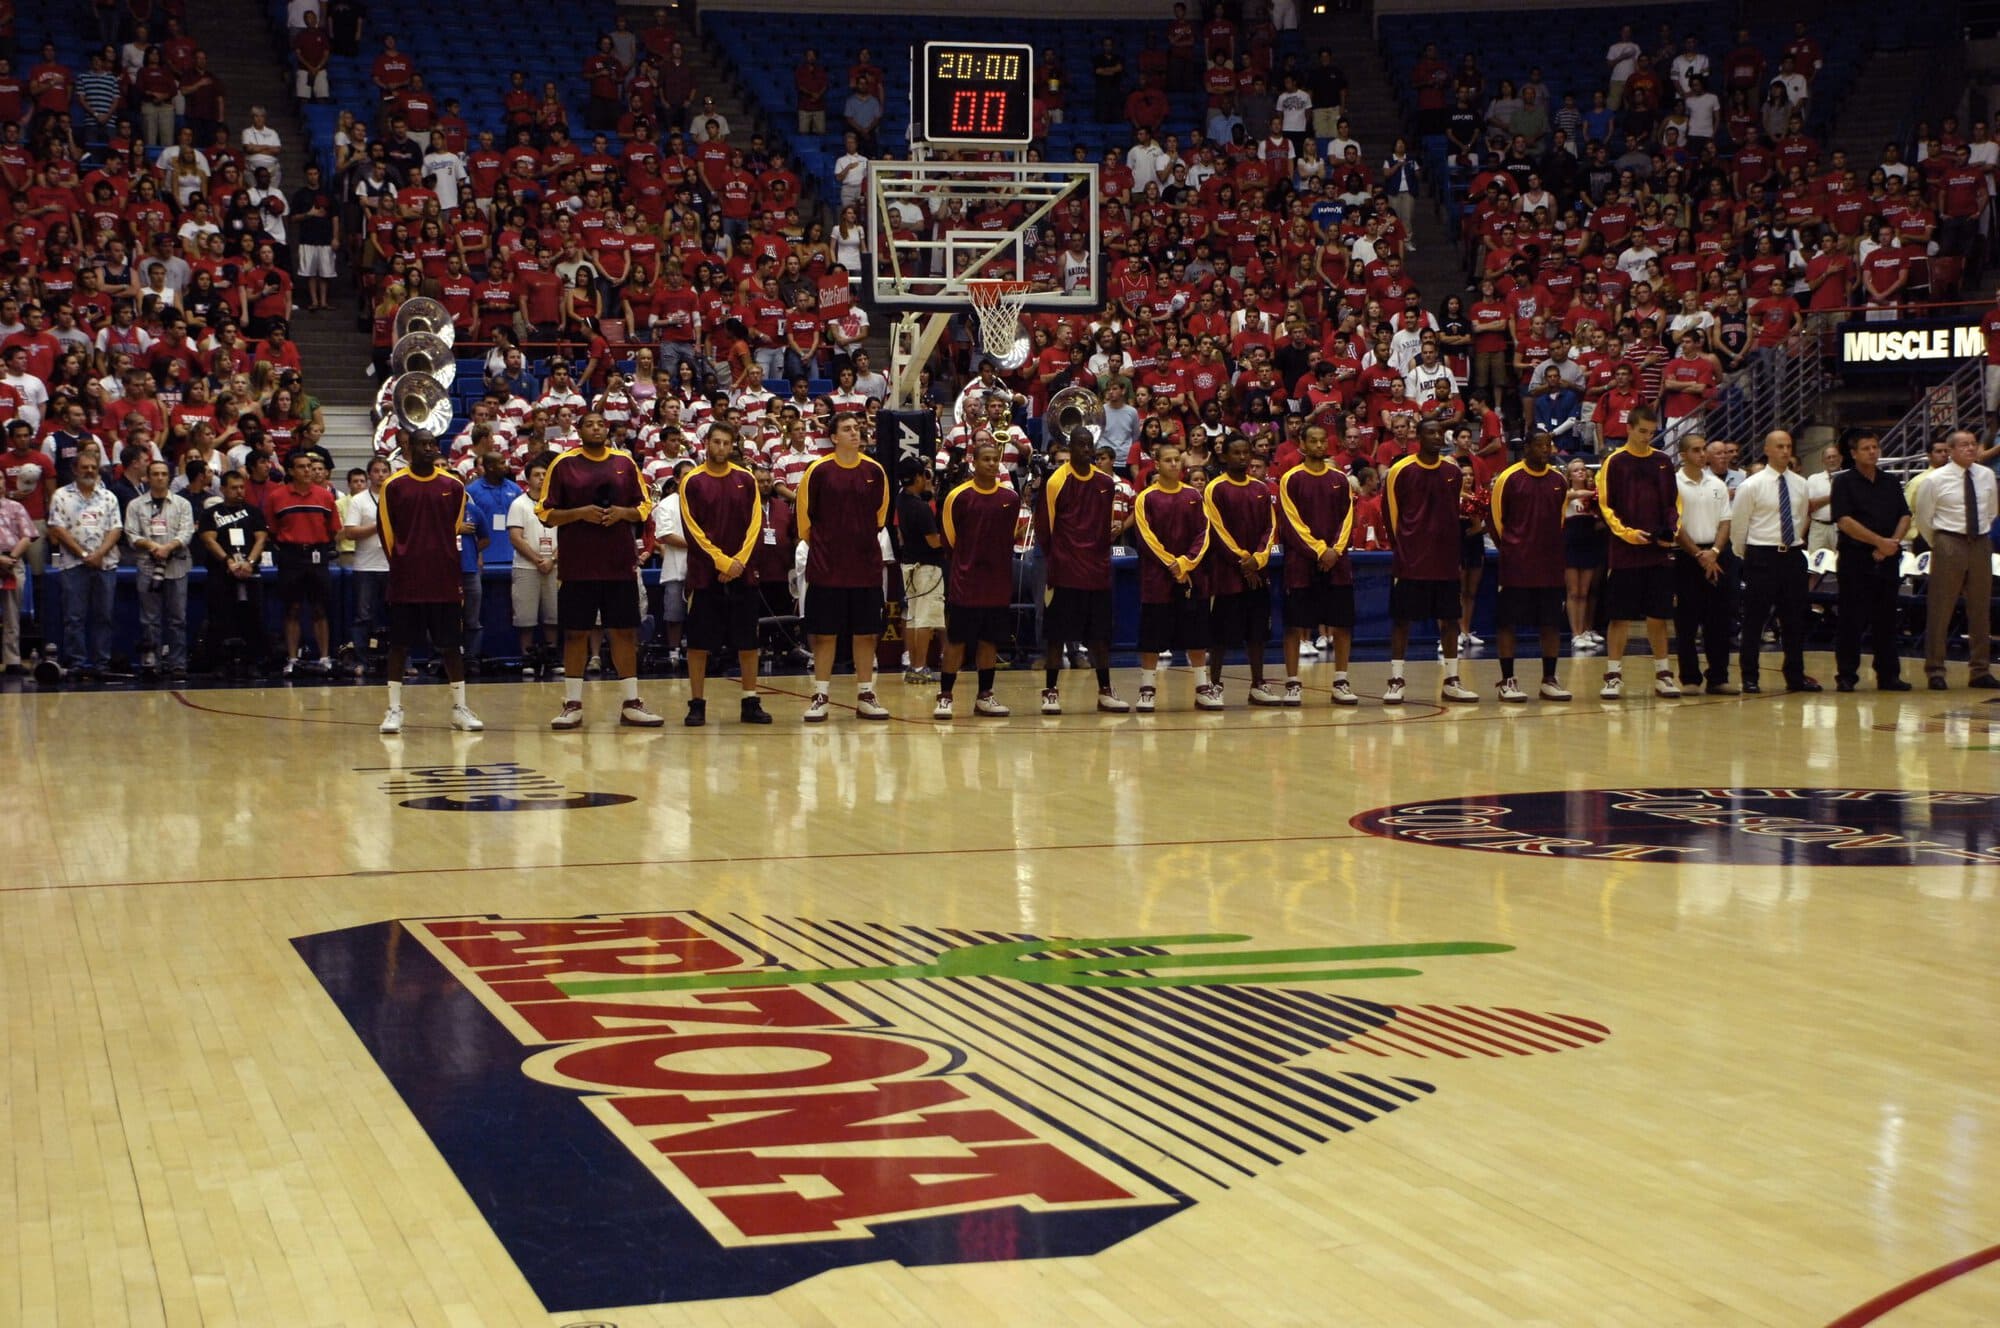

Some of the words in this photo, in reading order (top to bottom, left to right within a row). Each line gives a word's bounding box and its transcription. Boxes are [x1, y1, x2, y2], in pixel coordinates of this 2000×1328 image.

[938, 53, 1019, 80] 20:00
[951, 91, 1007, 132] 00
[1843, 330, 1949, 362] MUSCLE
[1601, 788, 1999, 805] LUTE
[1377, 804, 1705, 859] COURT
[412, 912, 1155, 1244] ARIZONA
